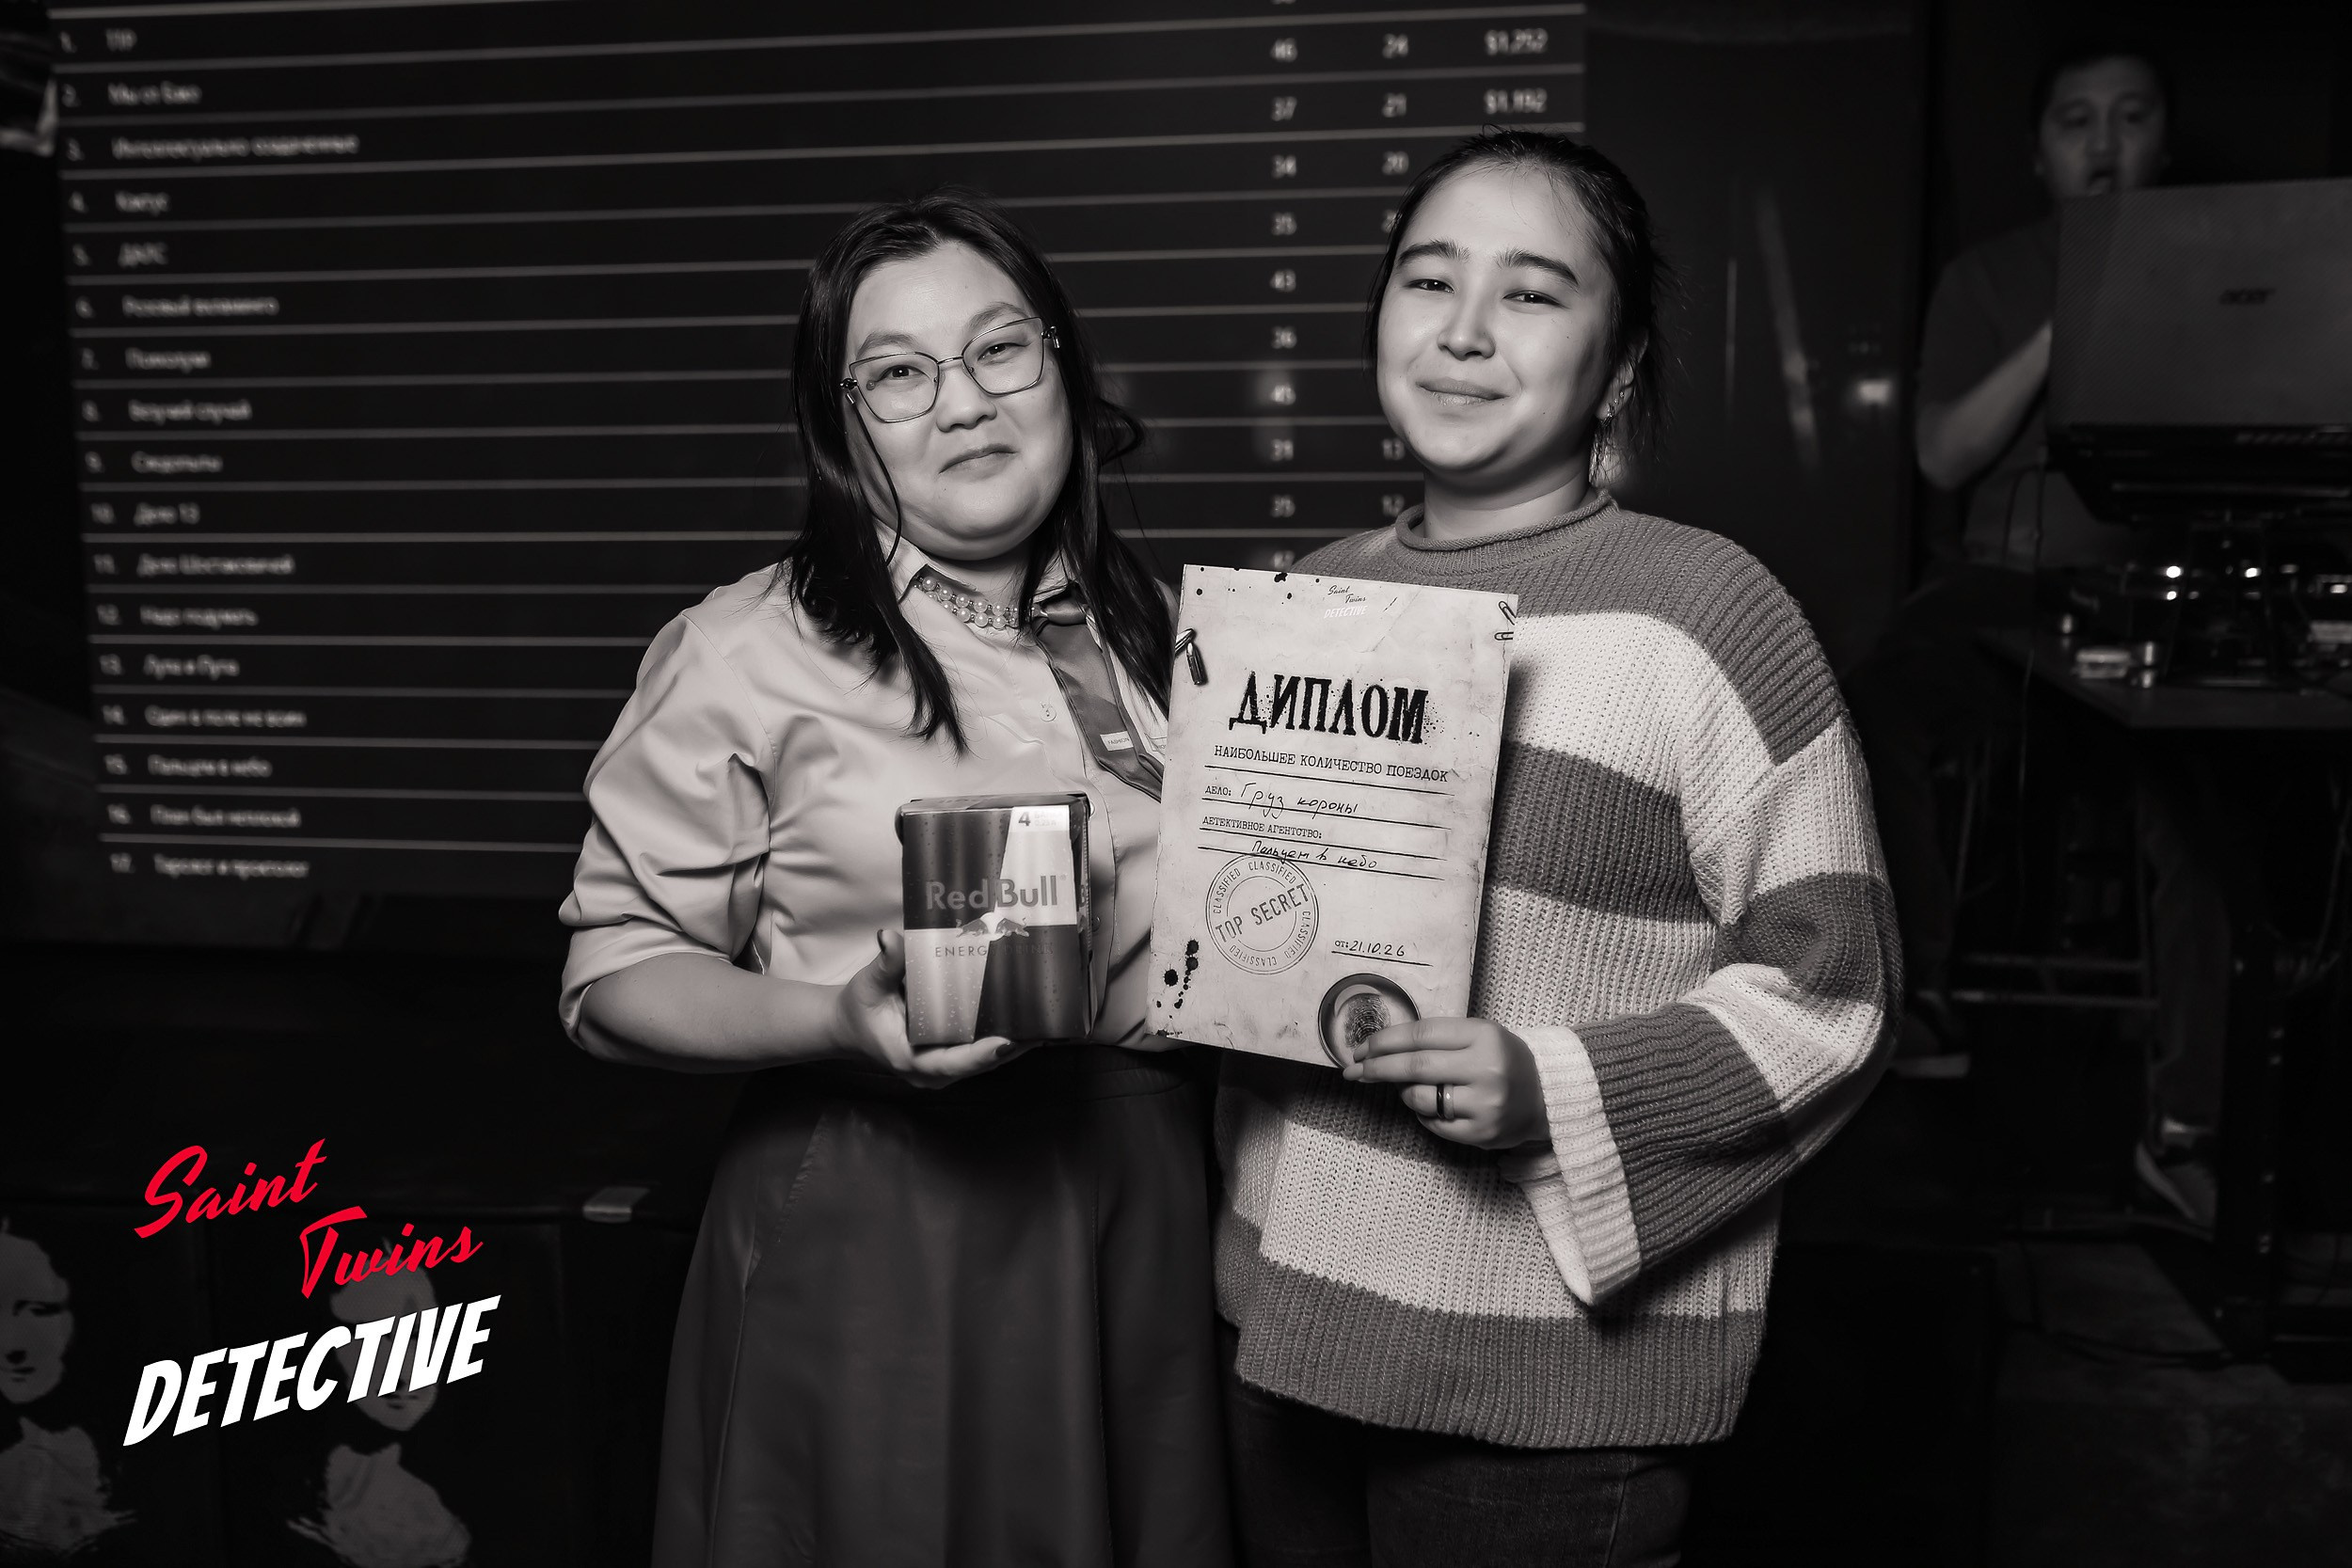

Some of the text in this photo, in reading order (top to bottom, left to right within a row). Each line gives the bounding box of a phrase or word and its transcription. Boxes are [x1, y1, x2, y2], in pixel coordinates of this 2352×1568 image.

[1327, 584, 1351, 595] Saint
[1345, 594, 1367, 604] Twins
[1324, 605, 1368, 620] DETECTIVE
[1229, 671, 1429, 743] ДИПЛОМ
[1214, 745, 1449, 783] НАИБОЛЬШЕЕ КОЛИЧЕСТВО ПОЕЗДОК
[1204, 784, 1232, 797] ДЕЛО:
[1240, 782, 1359, 819] Груз короны
[1018, 812, 1031, 827] 4
[1202, 816, 1323, 840] ДЕТЕКТИВНОЕ АГЕНТСТВО:
[1248, 860, 1296, 886] CLASSIFIED
[925, 875, 1057, 911] Red Bull
[1213, 867, 1241, 914] CLASSIFIED
[1215, 882, 1311, 943] TOP SECRET
[1284, 910, 1311, 959] CLASSIFIED
[1229, 944, 1278, 967] CLASSIFIED
